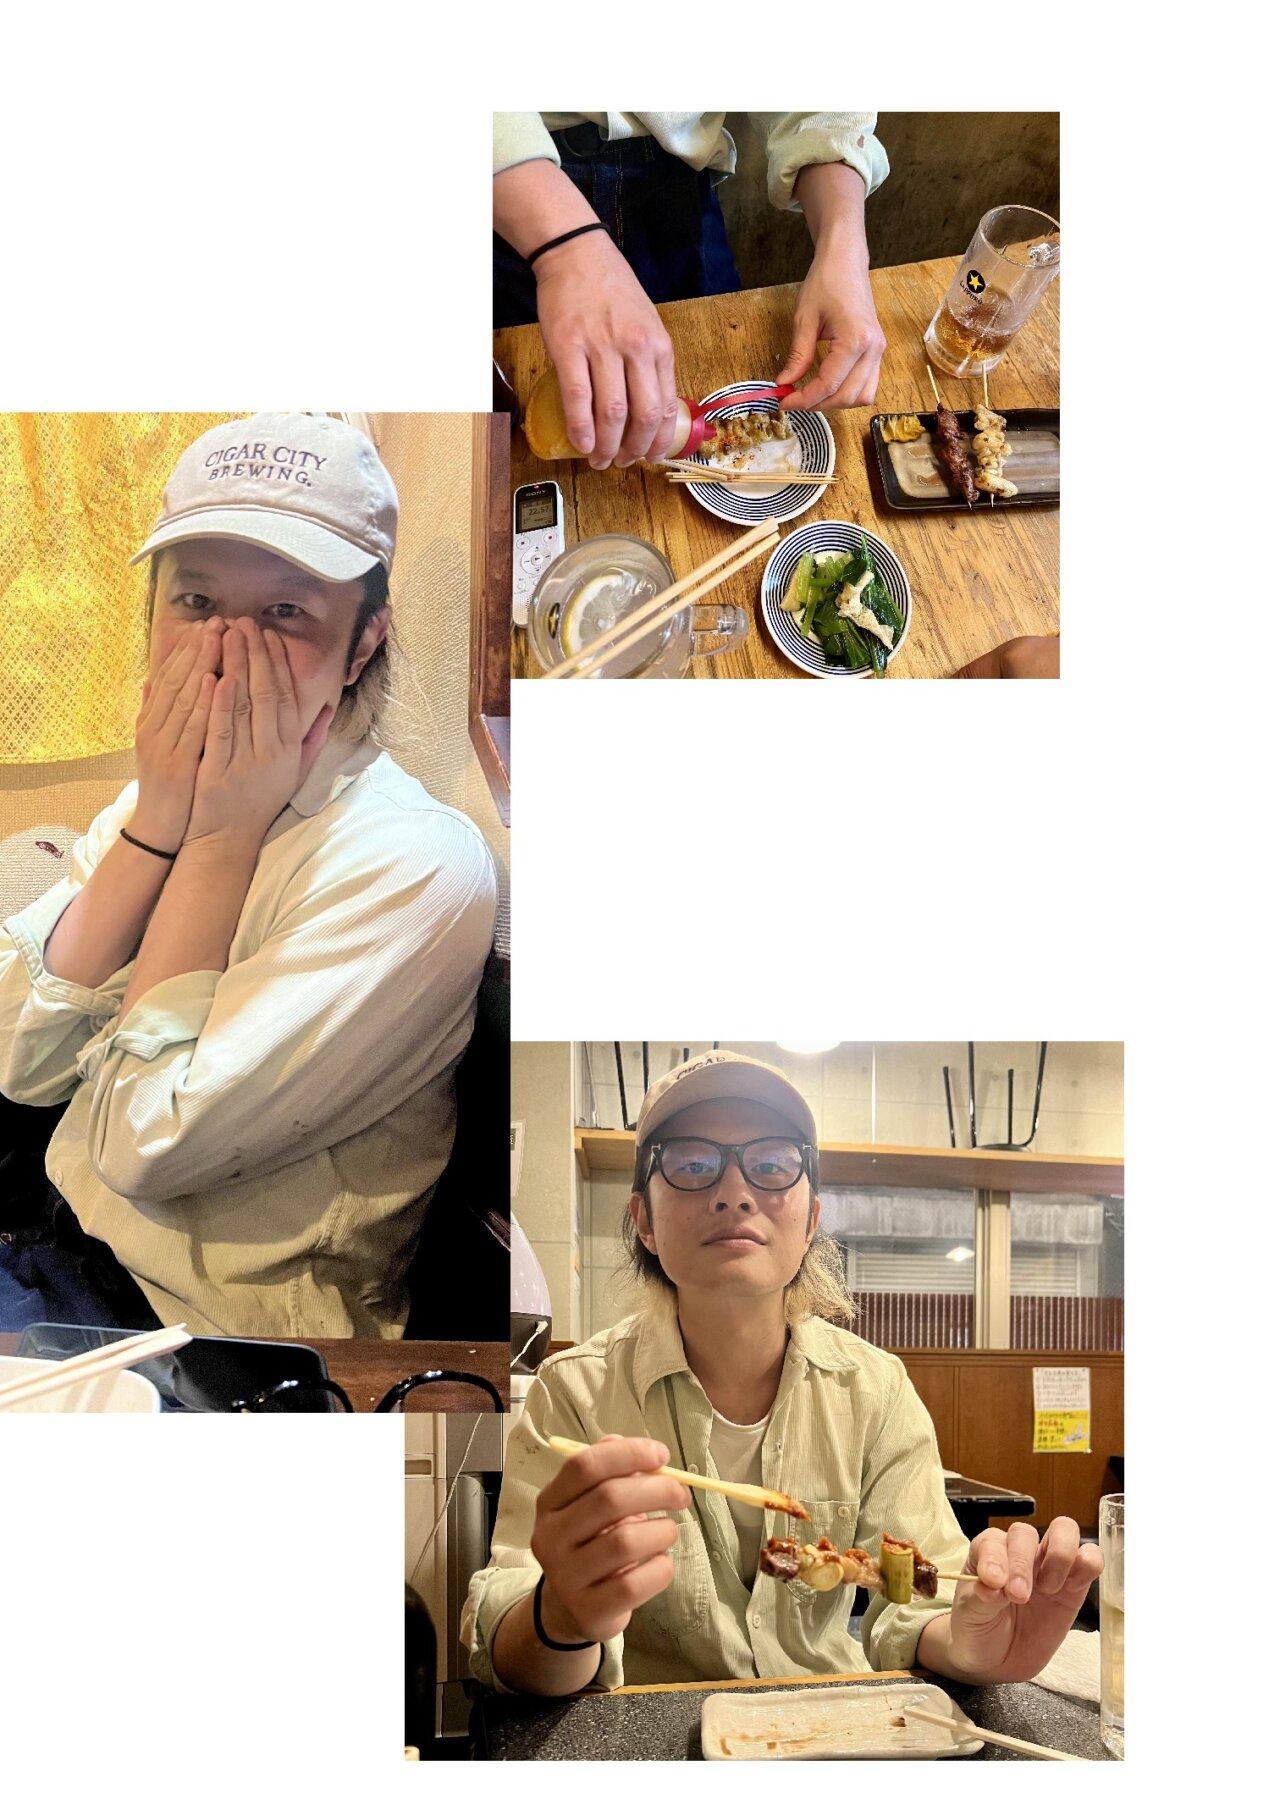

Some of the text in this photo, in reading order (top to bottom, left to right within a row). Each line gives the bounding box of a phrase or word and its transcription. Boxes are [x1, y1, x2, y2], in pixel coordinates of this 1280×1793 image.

[205, 443, 327, 471] CIGAR CITY
[208, 463, 312, 487] BREWING.
